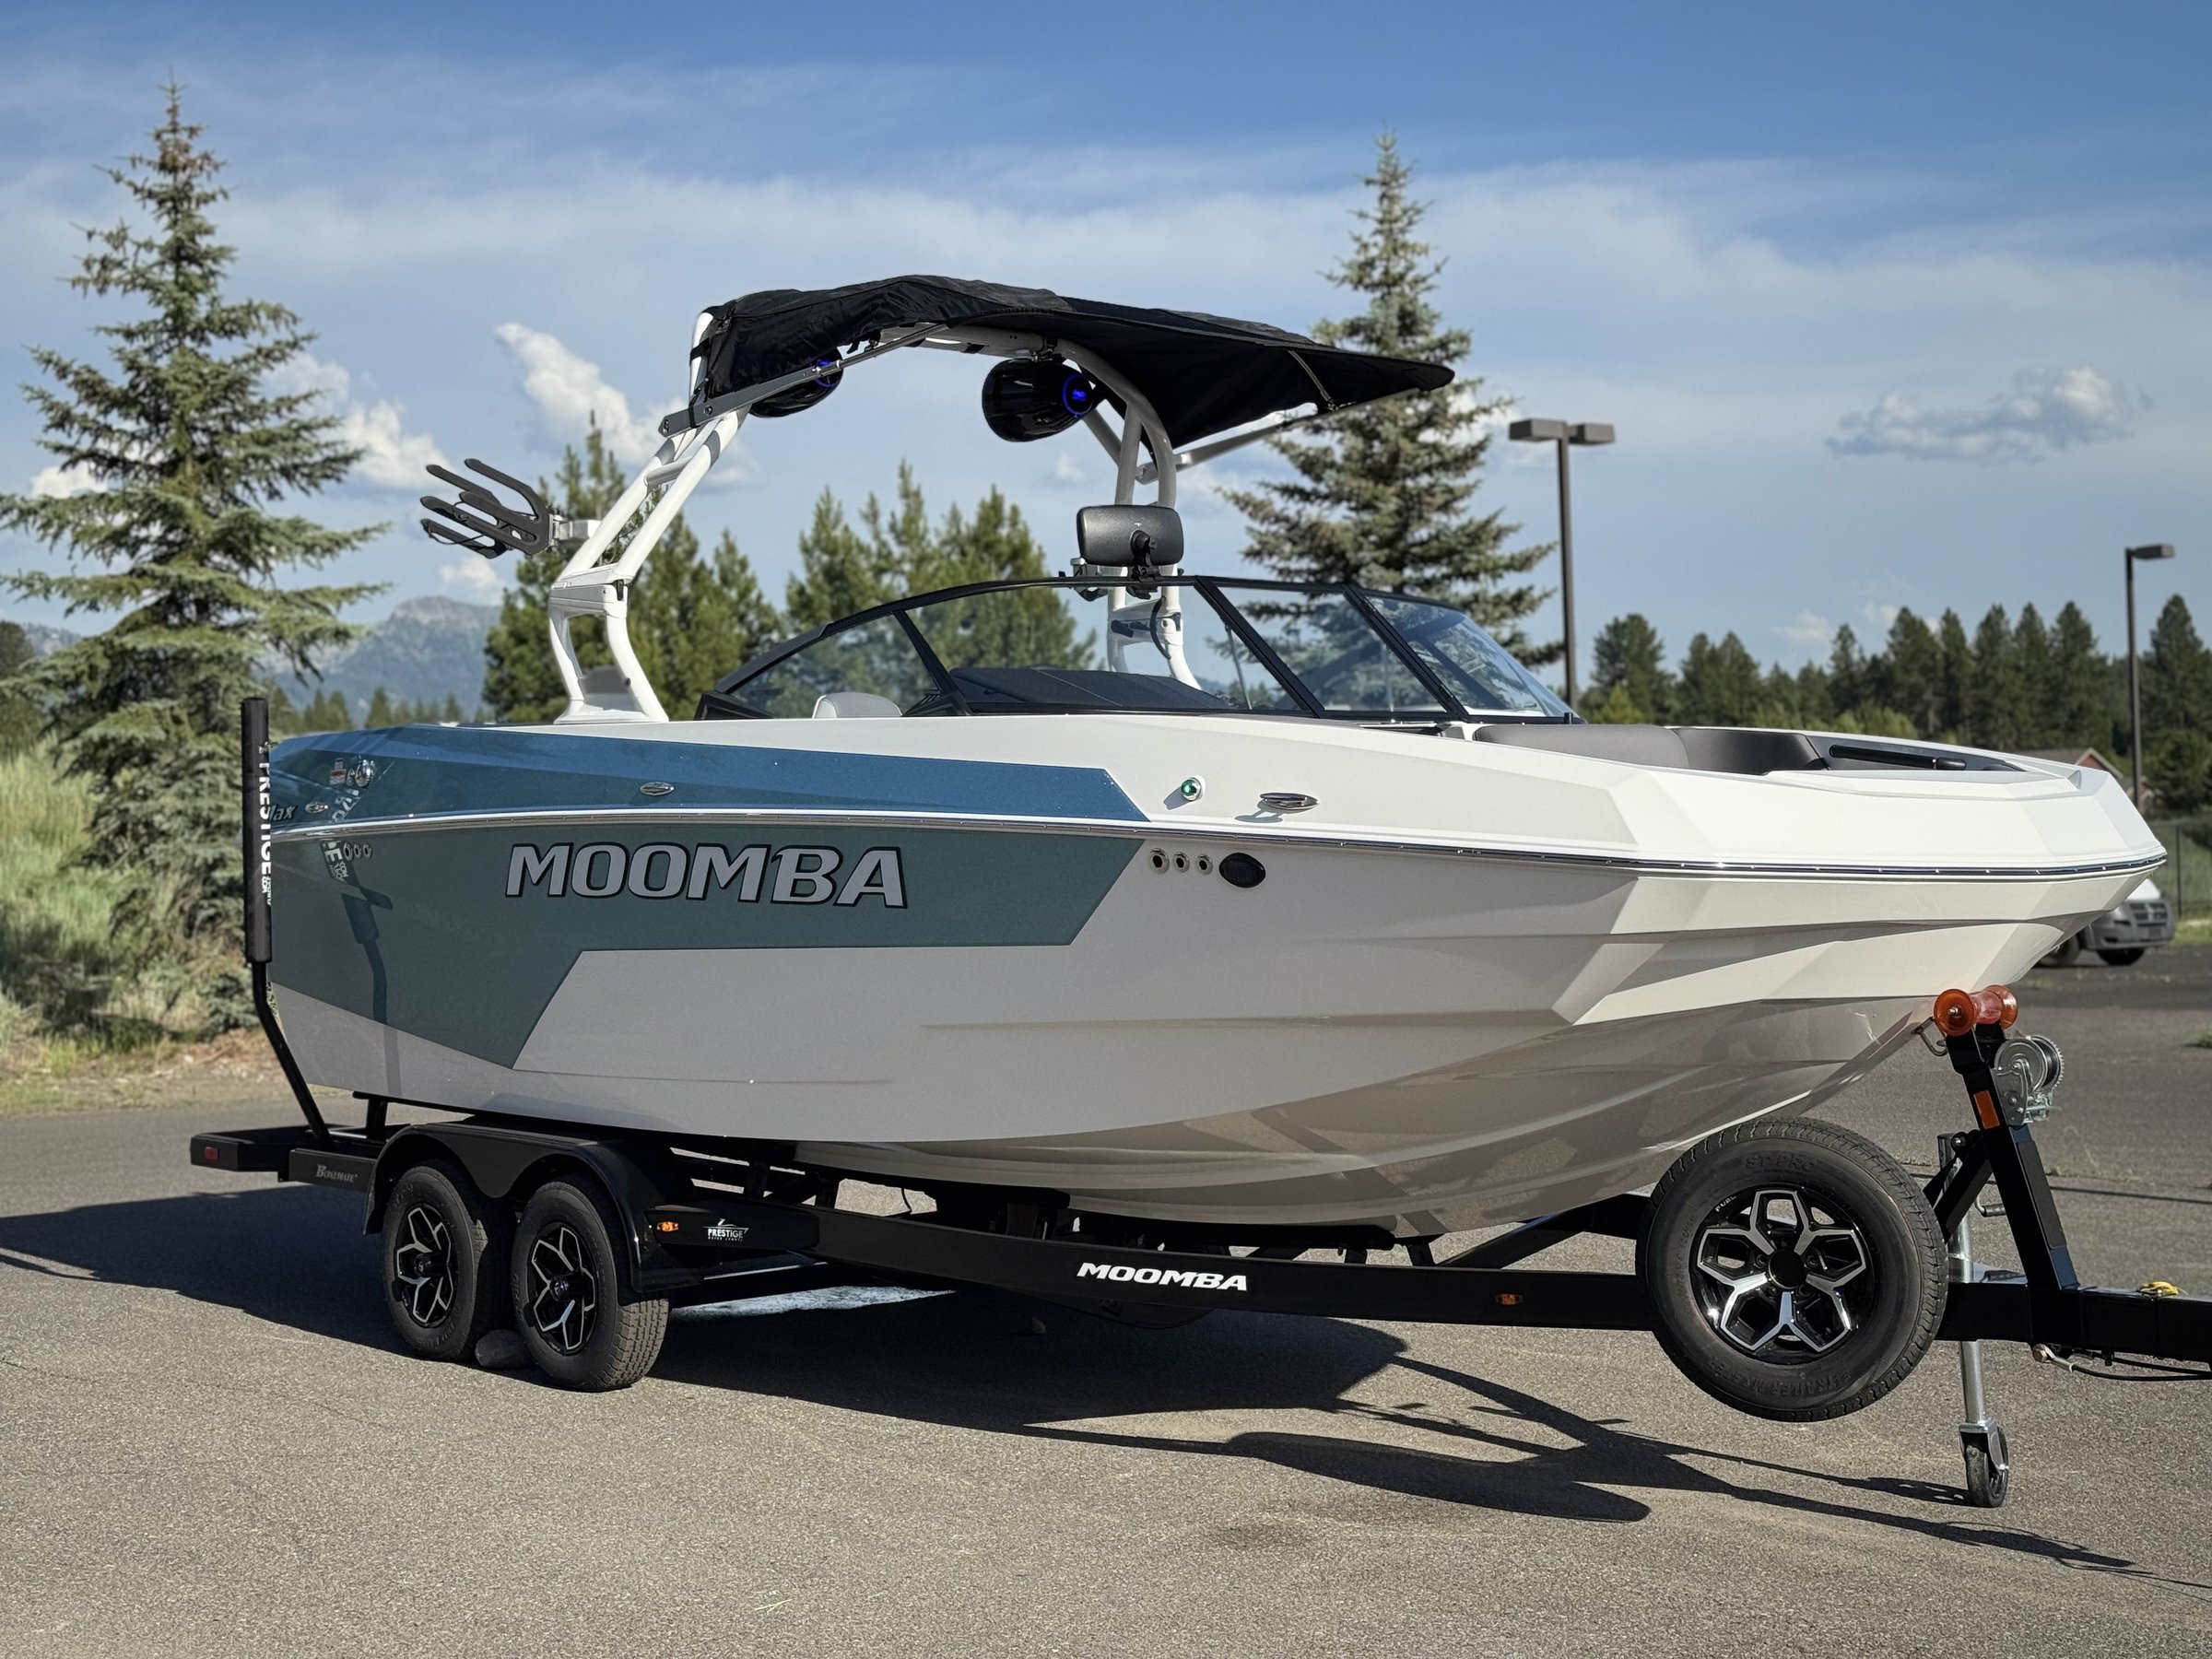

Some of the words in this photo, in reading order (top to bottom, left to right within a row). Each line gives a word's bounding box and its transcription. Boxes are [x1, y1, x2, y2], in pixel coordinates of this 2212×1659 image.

[504, 842, 909, 909] MOOMBA
[708, 1228, 744, 1239] PRESTIGE
[1076, 1262, 1247, 1291] MOOMBA
